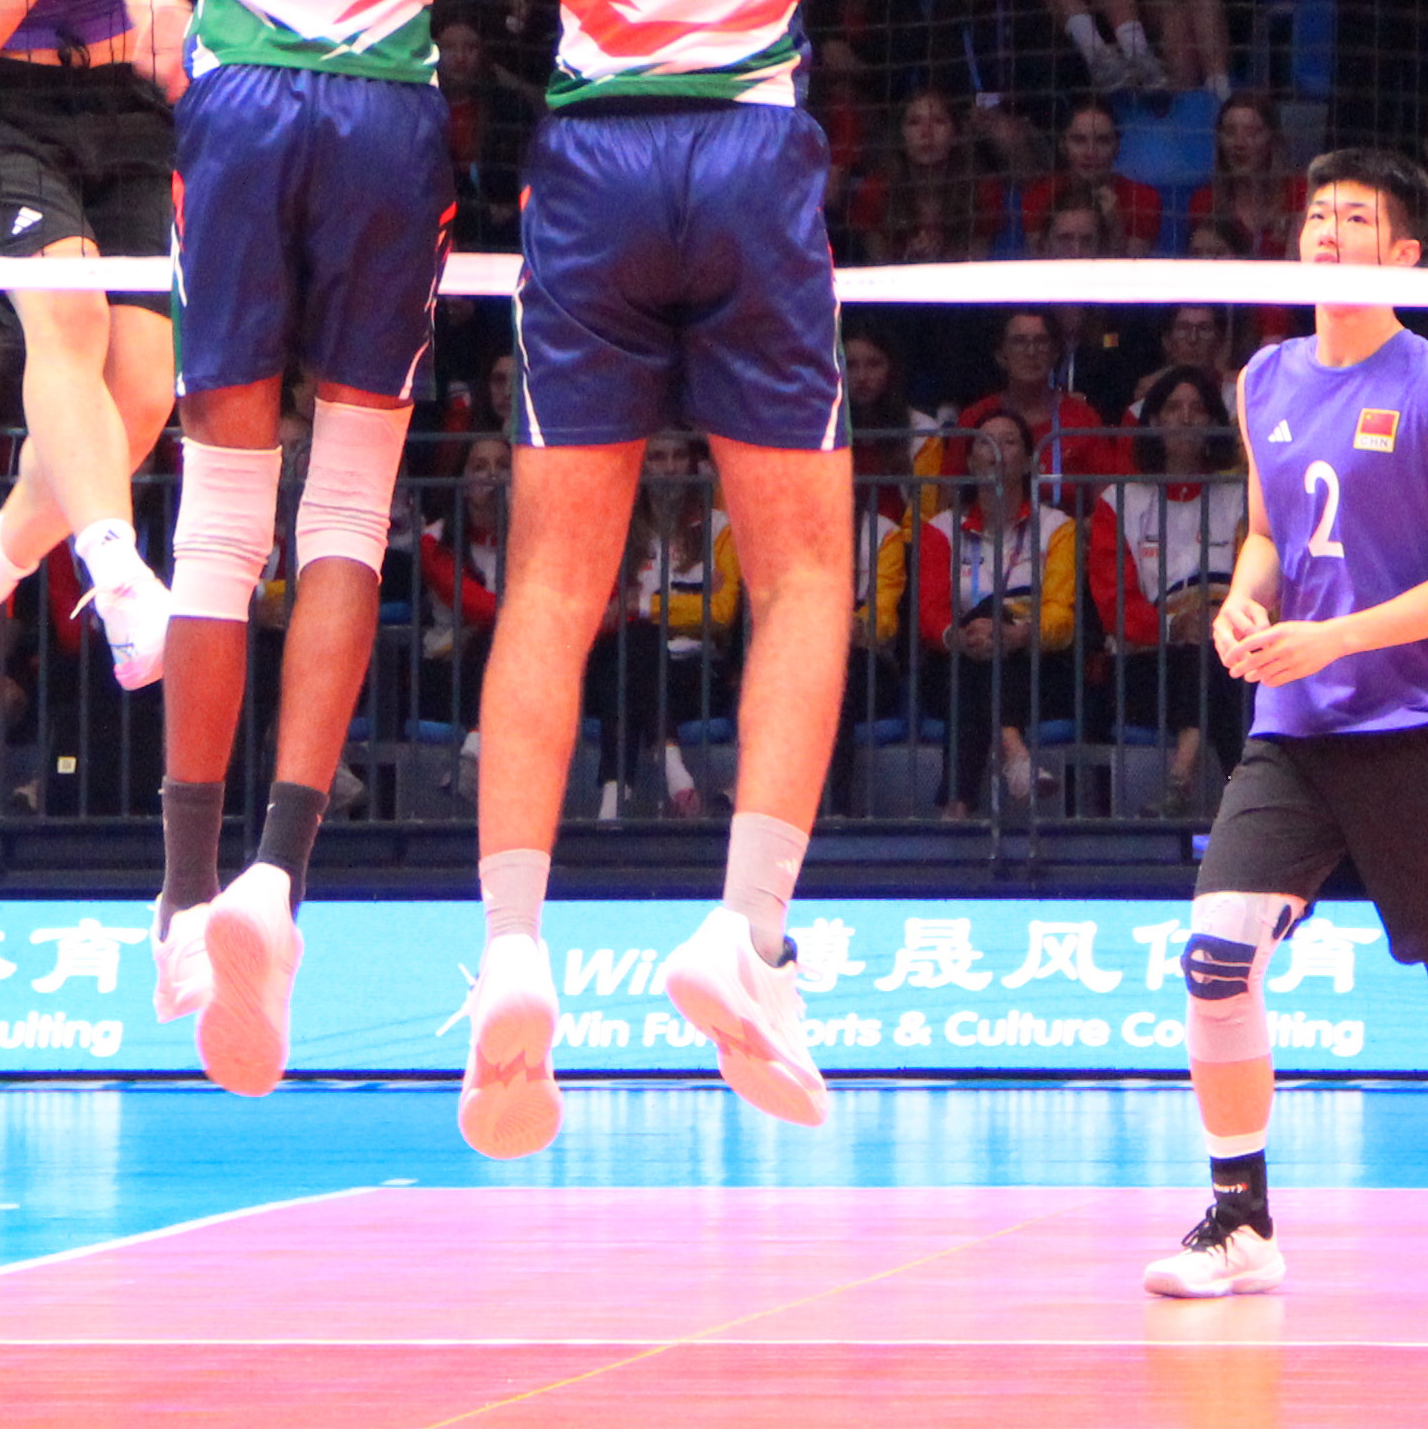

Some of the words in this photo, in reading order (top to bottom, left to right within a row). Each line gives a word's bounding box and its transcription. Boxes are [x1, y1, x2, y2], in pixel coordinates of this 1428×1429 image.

[1360, 435, 1389, 448] CHN
[1304, 460, 1345, 559] 2
[893, 1011, 932, 1047] &
[944, 1010, 1111, 1048] Culture
